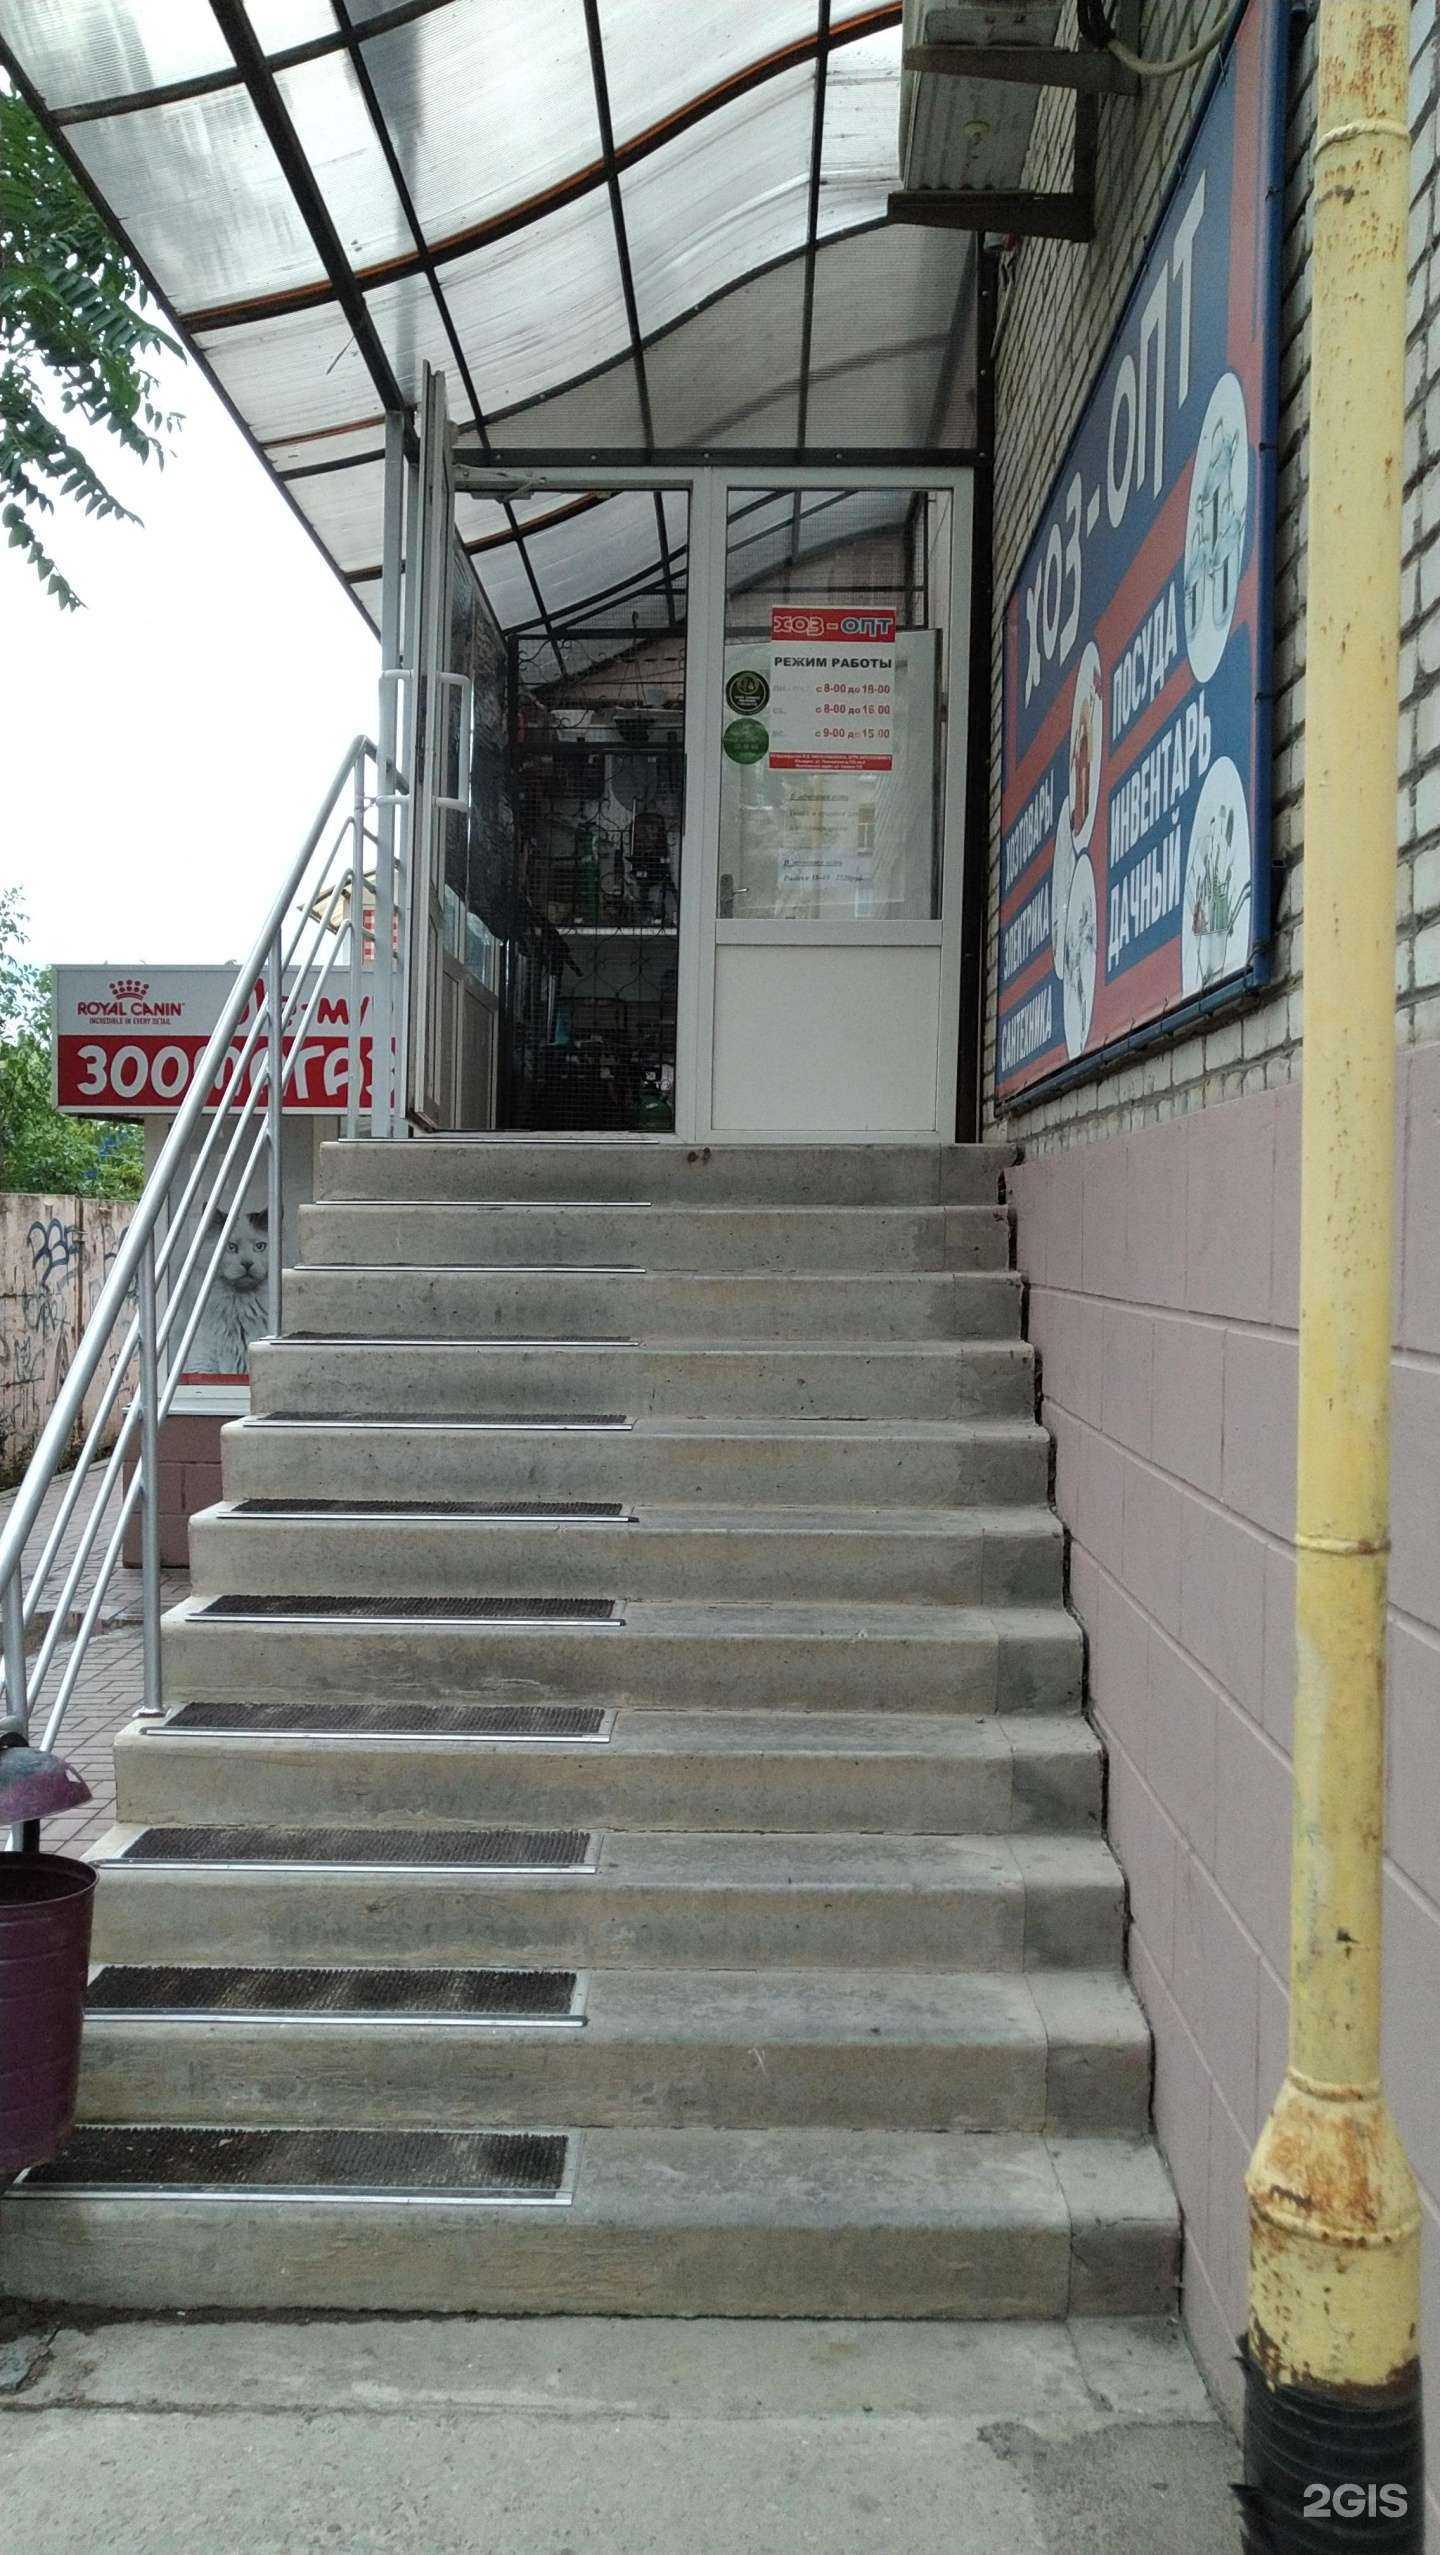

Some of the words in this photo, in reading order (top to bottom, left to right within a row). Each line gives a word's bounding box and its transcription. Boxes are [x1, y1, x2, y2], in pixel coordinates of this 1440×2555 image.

[1024, 168, 1205, 709] ХОЗ-ОПТ
[773, 616, 893, 638] ХОЗ-ОПТ
[774, 656, 828, 668] РЕЖИМ
[831, 658, 893, 669] РАБОТЫ
[1112, 580, 1179, 743] ПОСУДА
[823, 683, 847, 693] 8-00
[862, 684, 890, 694] 18-00
[823, 704, 846, 714] 8-00
[862, 705, 890, 714] 1600
[823, 728, 845, 738] 9-00
[862, 728, 890, 738] 1500
[1109, 688, 1212, 869] ИНВЕНТАРЬ
[1004, 768, 1054, 891] ХОЗТОВАРЫ
[1003, 880, 1050, 981] ЭЛЕКТРИКА
[1107, 808, 1183, 974] ДАЧНЫЙ
[77, 1001, 127, 1016] ROYAL
[130, 1001, 182, 1017] CANIN
[1001, 983, 1052, 1073] САНТЕХНИКА
